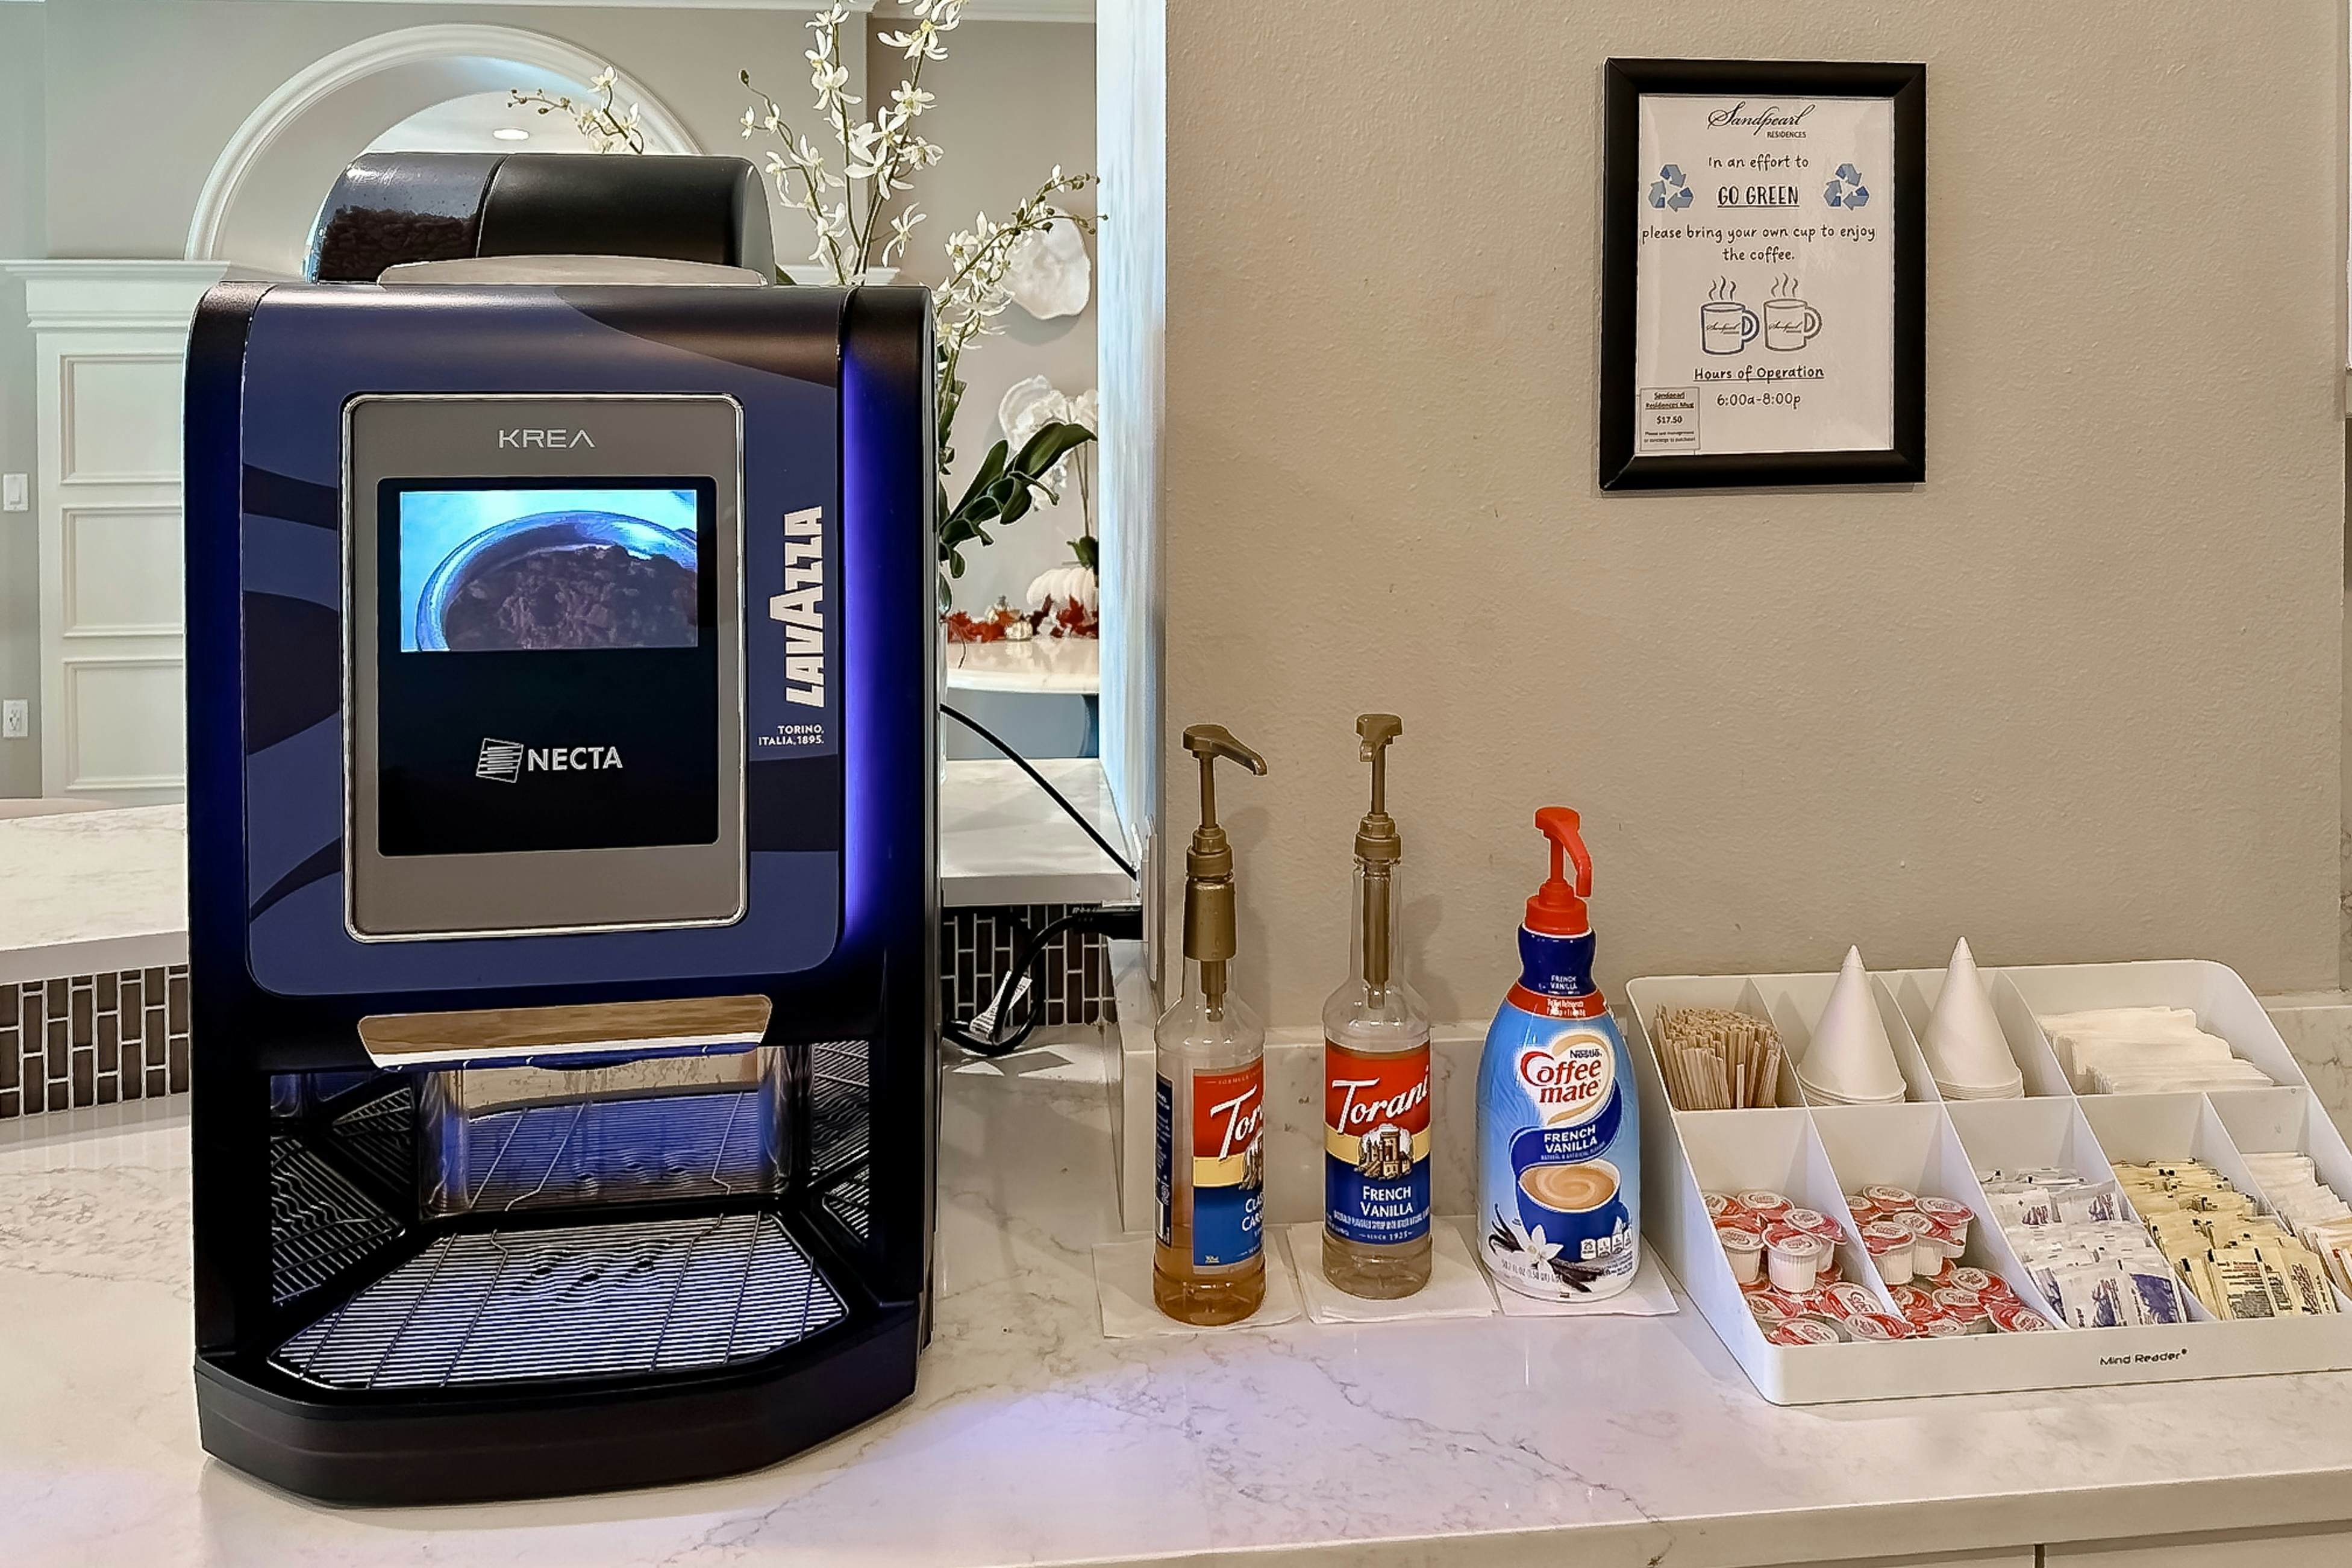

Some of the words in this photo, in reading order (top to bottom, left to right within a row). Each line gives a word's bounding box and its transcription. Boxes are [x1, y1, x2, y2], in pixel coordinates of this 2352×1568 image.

[1707, 101, 1816, 136] Sandpearl
[1709, 157, 1722, 168] In
[1727, 158, 1745, 168] an
[1750, 154, 1790, 171] effort
[1795, 155, 1809, 168] to
[1718, 186, 1739, 205] GO
[1747, 186, 1798, 204] GREEN
[1642, 225, 1681, 244] please
[1687, 225, 1722, 243] bring
[1728, 228, 1756, 243] your
[1762, 229, 1788, 237] own
[1793, 228, 1816, 242] cup
[1821, 224, 1834, 237] to
[1840, 226, 1875, 242] enjoy
[1722, 248, 1745, 261] the
[1750, 246, 1795, 263] coffee.
[1695, 368, 1731, 380] Hours
[1738, 365, 1753, 382] of
[1757, 365, 1824, 384] Operation
[1717, 393, 1801, 409] 6:00a-8:00p
[1657, 416, 1683, 425] $17.50
[499, 429, 595, 448] KREA
[770, 506, 824, 708] LAVAZZA
[528, 746, 623, 771] NECTA
[1520, 1051, 1601, 1086] Coffee
[1332, 1064, 1429, 1134] Torani
[1539, 1079, 1599, 1103] mate
[1544, 1124, 1595, 1143] FRENCH
[1545, 1136, 1597, 1153] VANILLA
[1363, 1185, 1411, 1201] FRENCH
[1360, 1201, 1413, 1217] VANILLA
[2100, 1355, 2131, 1366] Mind
[2135, 1352, 2180, 1363] Reader
